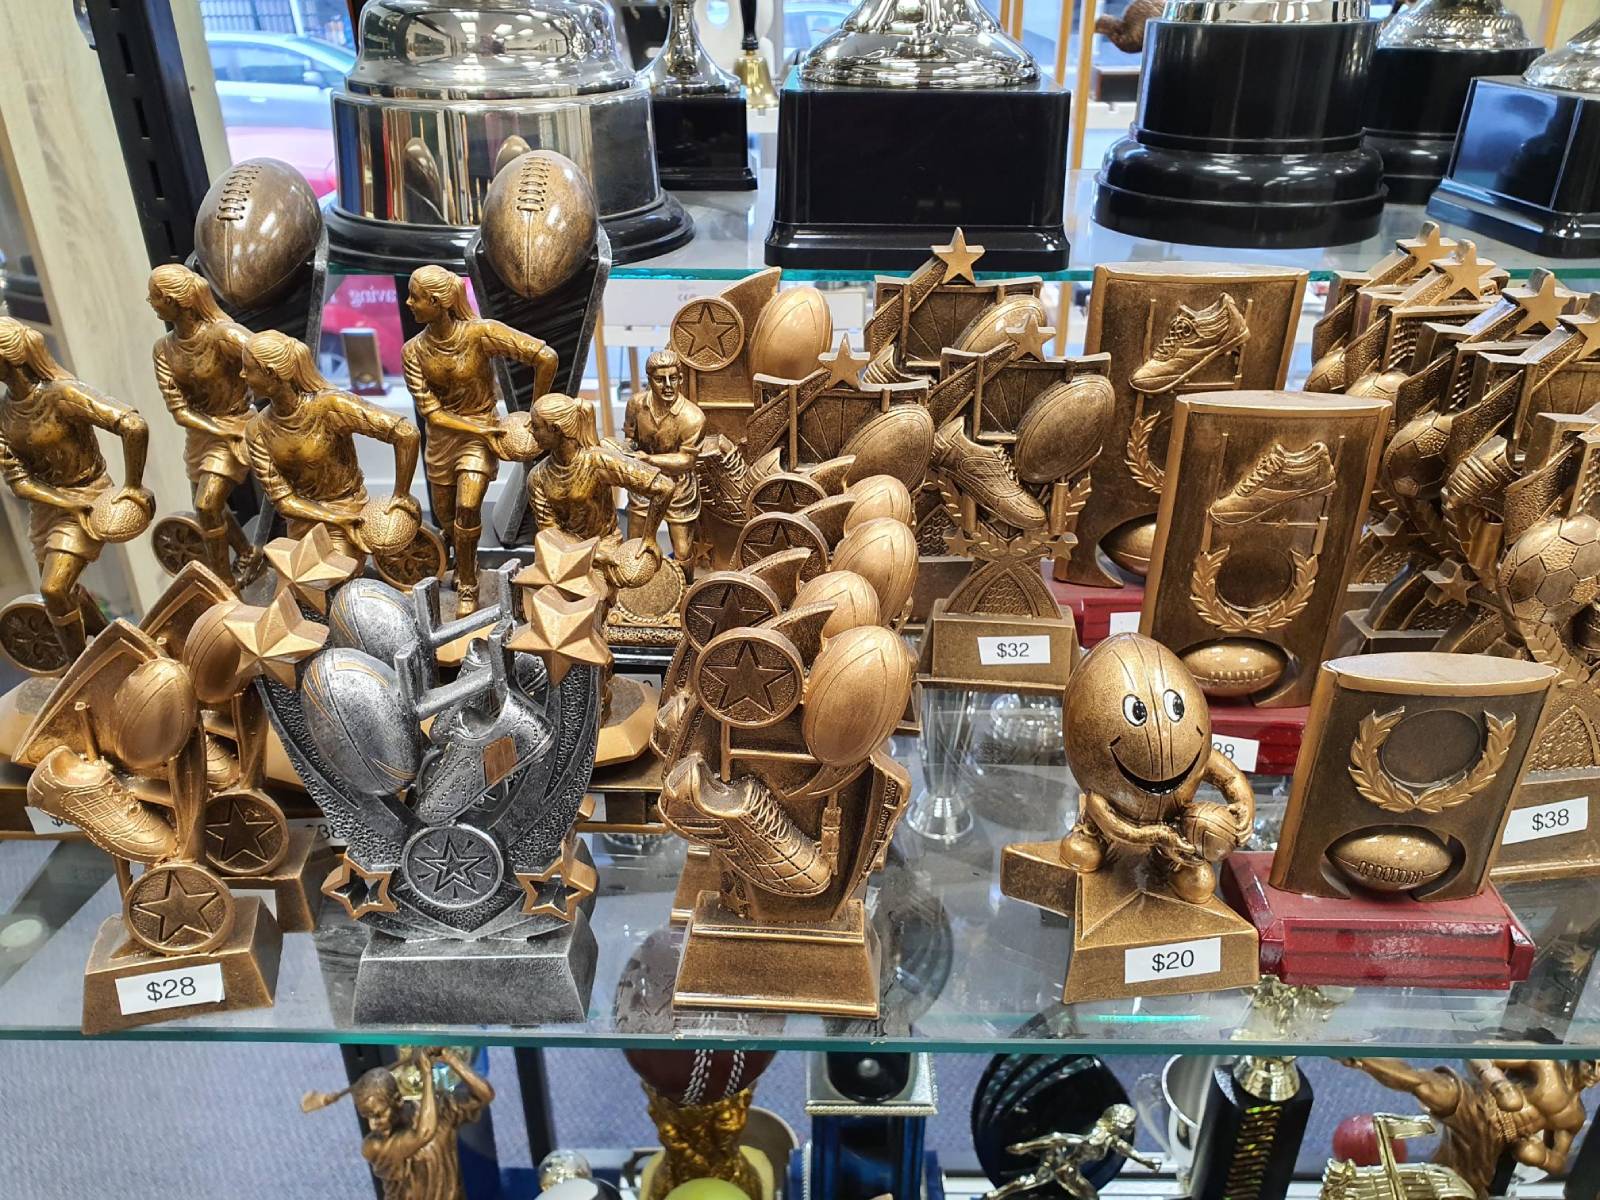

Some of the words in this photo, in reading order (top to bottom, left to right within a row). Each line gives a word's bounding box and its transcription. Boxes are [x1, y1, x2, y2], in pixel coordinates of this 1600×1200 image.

[997, 643, 1029, 658] $32
[1532, 808, 1569, 831] $38
[1152, 950, 1194, 972] $20
[146, 977, 196, 1002] $28
